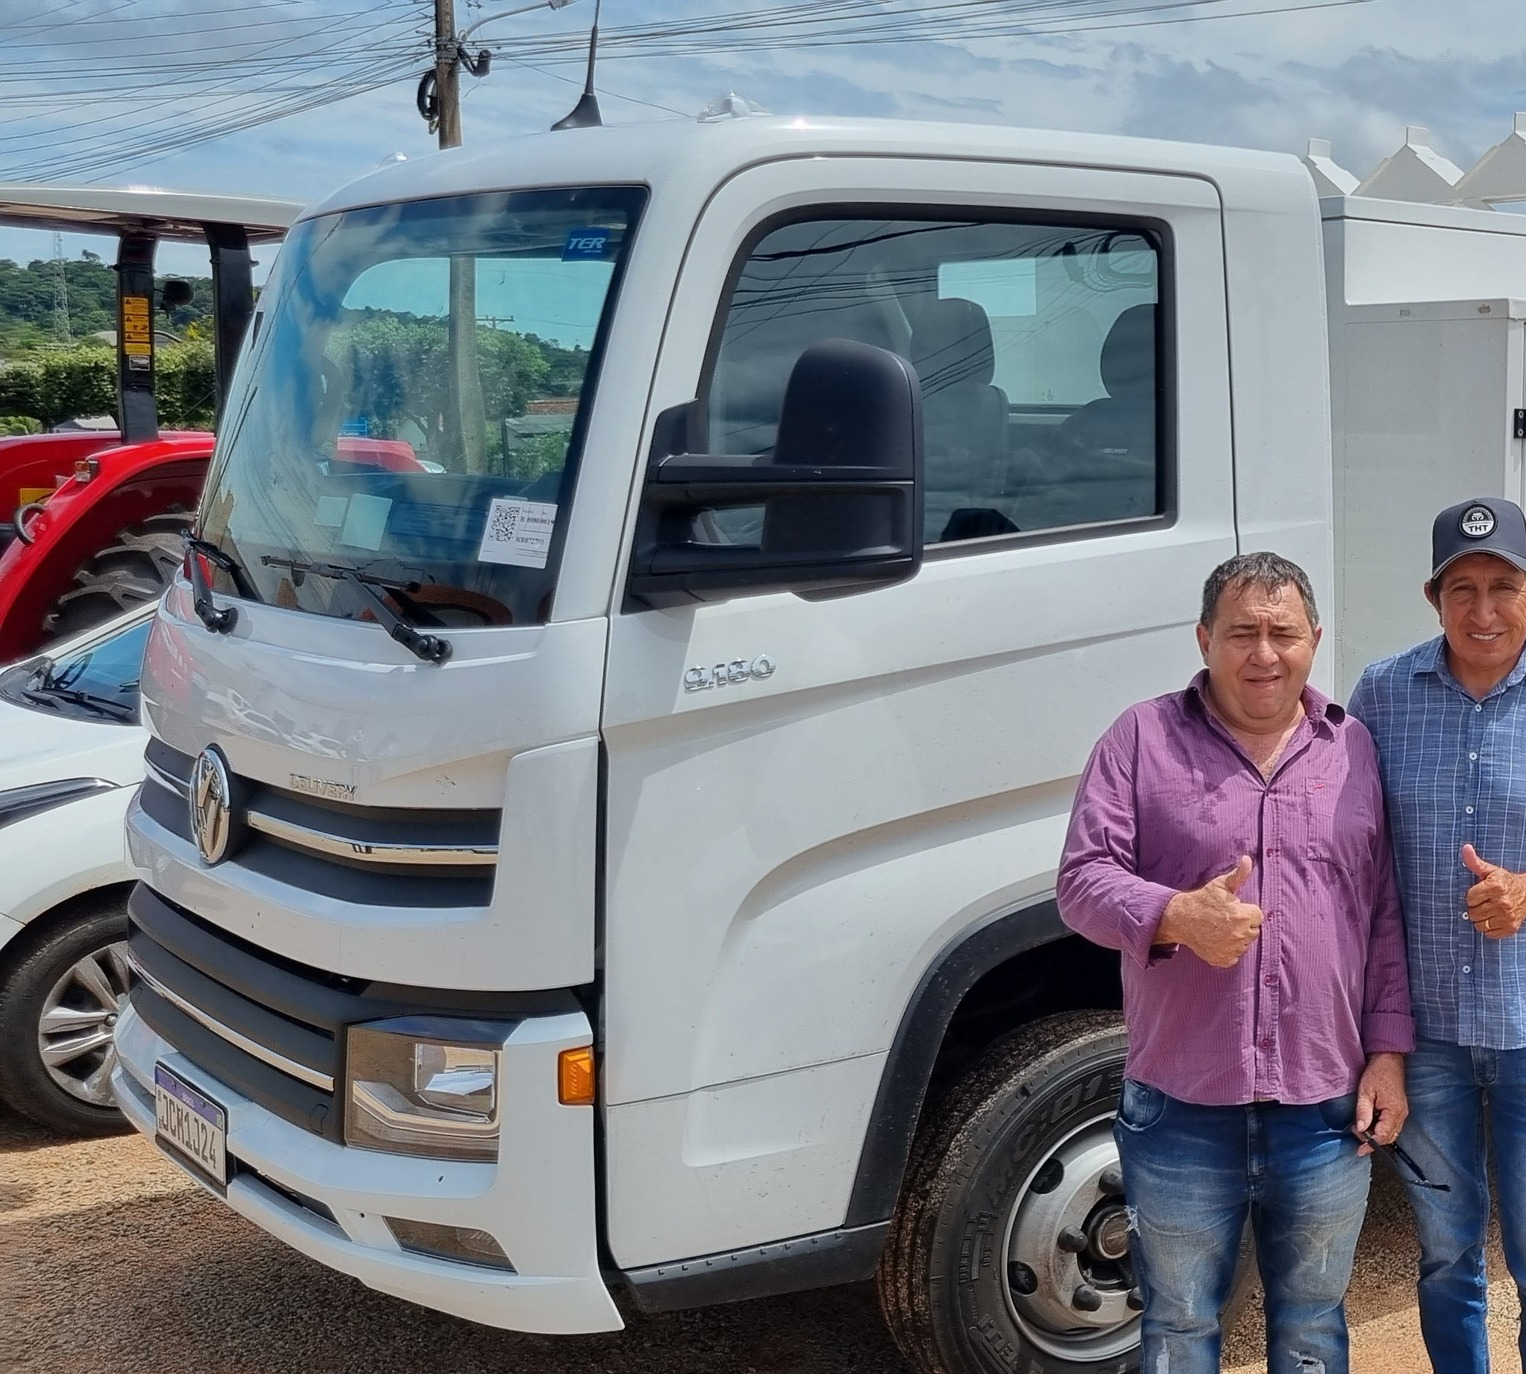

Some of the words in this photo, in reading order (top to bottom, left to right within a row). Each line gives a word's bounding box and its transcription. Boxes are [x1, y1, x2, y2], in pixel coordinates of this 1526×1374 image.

[1468, 524, 1489, 533] THT
[684, 653, 777, 692] 9.180
[289, 773, 358, 801] DELIVERY
